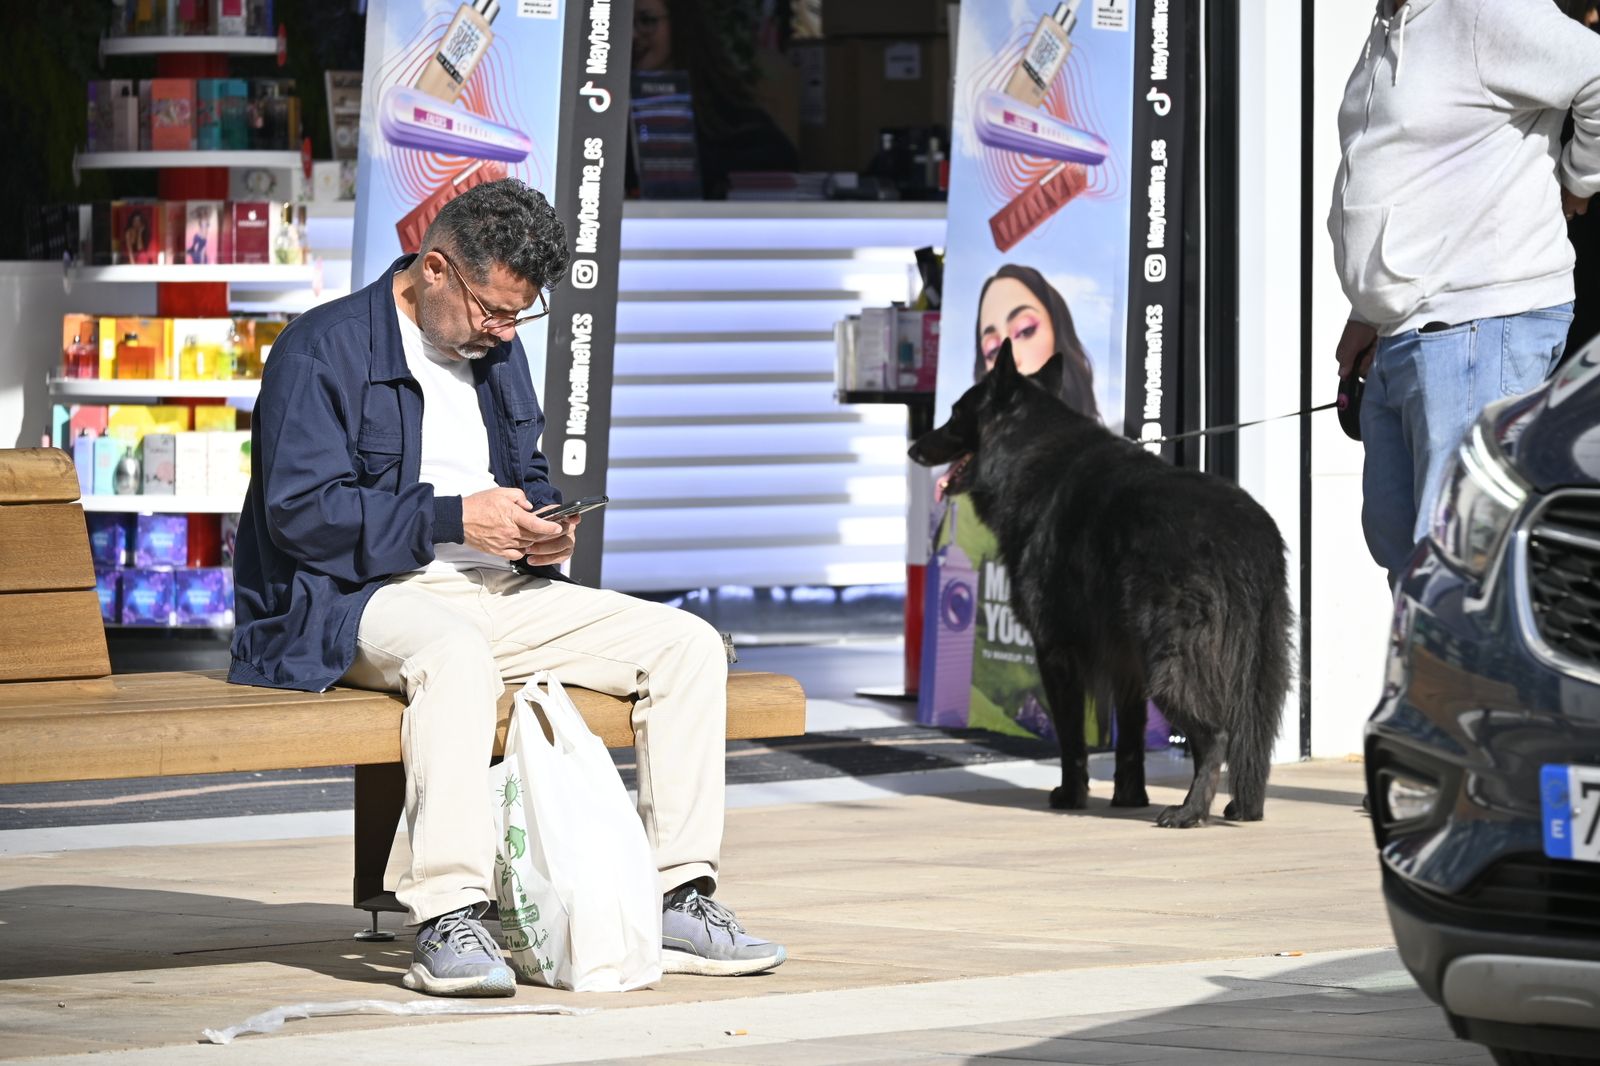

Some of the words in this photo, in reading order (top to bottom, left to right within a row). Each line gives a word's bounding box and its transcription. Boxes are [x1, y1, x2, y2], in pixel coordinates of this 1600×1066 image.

[576, 137, 604, 253] Maybelline_es
[1147, 139, 1168, 249] Maybelline_es
[1581, 782, 1600, 846] 7
